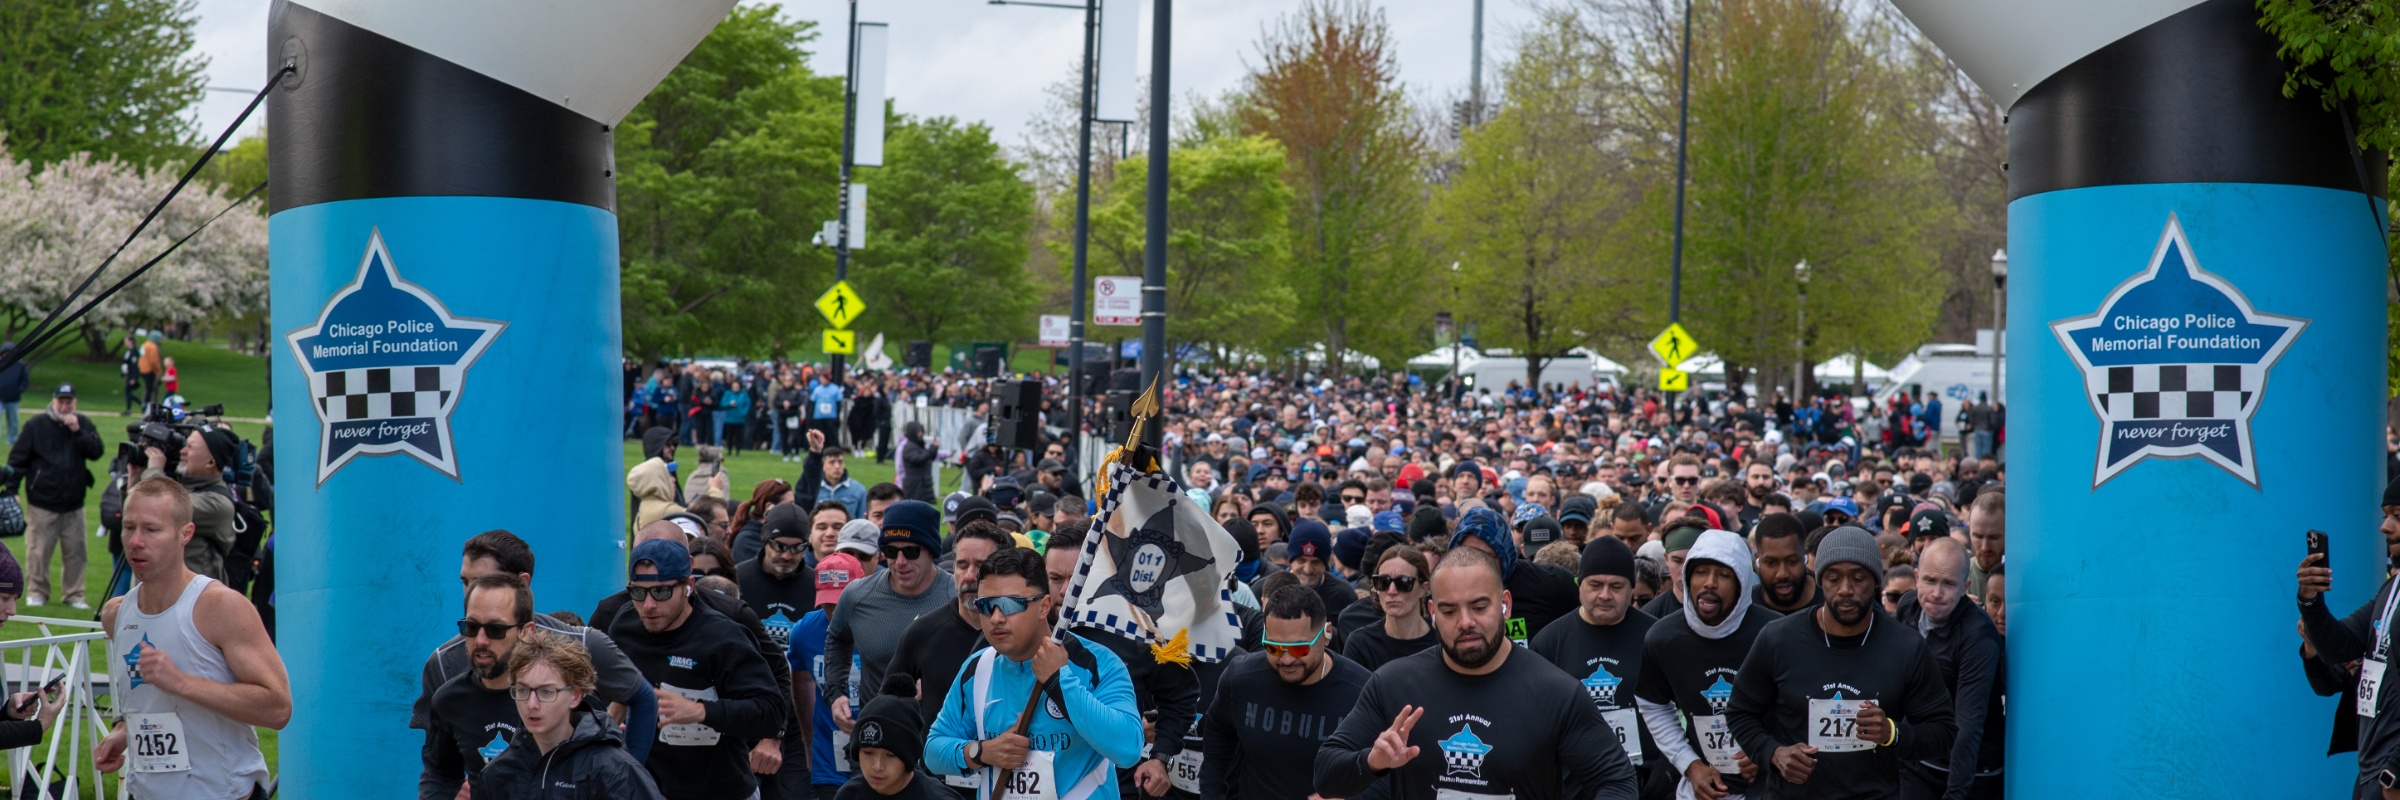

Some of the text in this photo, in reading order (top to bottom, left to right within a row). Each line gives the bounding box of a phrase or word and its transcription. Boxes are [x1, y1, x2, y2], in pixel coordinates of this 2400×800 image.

[329, 320, 434, 339] Chicago Police
[2114, 314, 2236, 333] Chicago Police
[313, 338, 458, 359] Memorial Foundation
[2092, 334, 2260, 352] Memorial Foundation
[334, 421, 431, 439] never forget
[2118, 422, 2231, 442] never forget
[1129, 528, 1185, 557] CHICAGO
[1138, 551, 1163, 567] 011
[1132, 569, 1156, 583] Dist.
[1717, 666, 1738, 676] Annua
[1823, 682, 1861, 696] 21st Annual
[2360, 678, 2376, 700] 65
[496, 721, 517, 733] Annua
[1245, 702, 1344, 741] NOBUL
[1448, 714, 1491, 727] 21st Annual
[135, 733, 179, 756] 2152
[1005, 771, 1041, 794] 462
